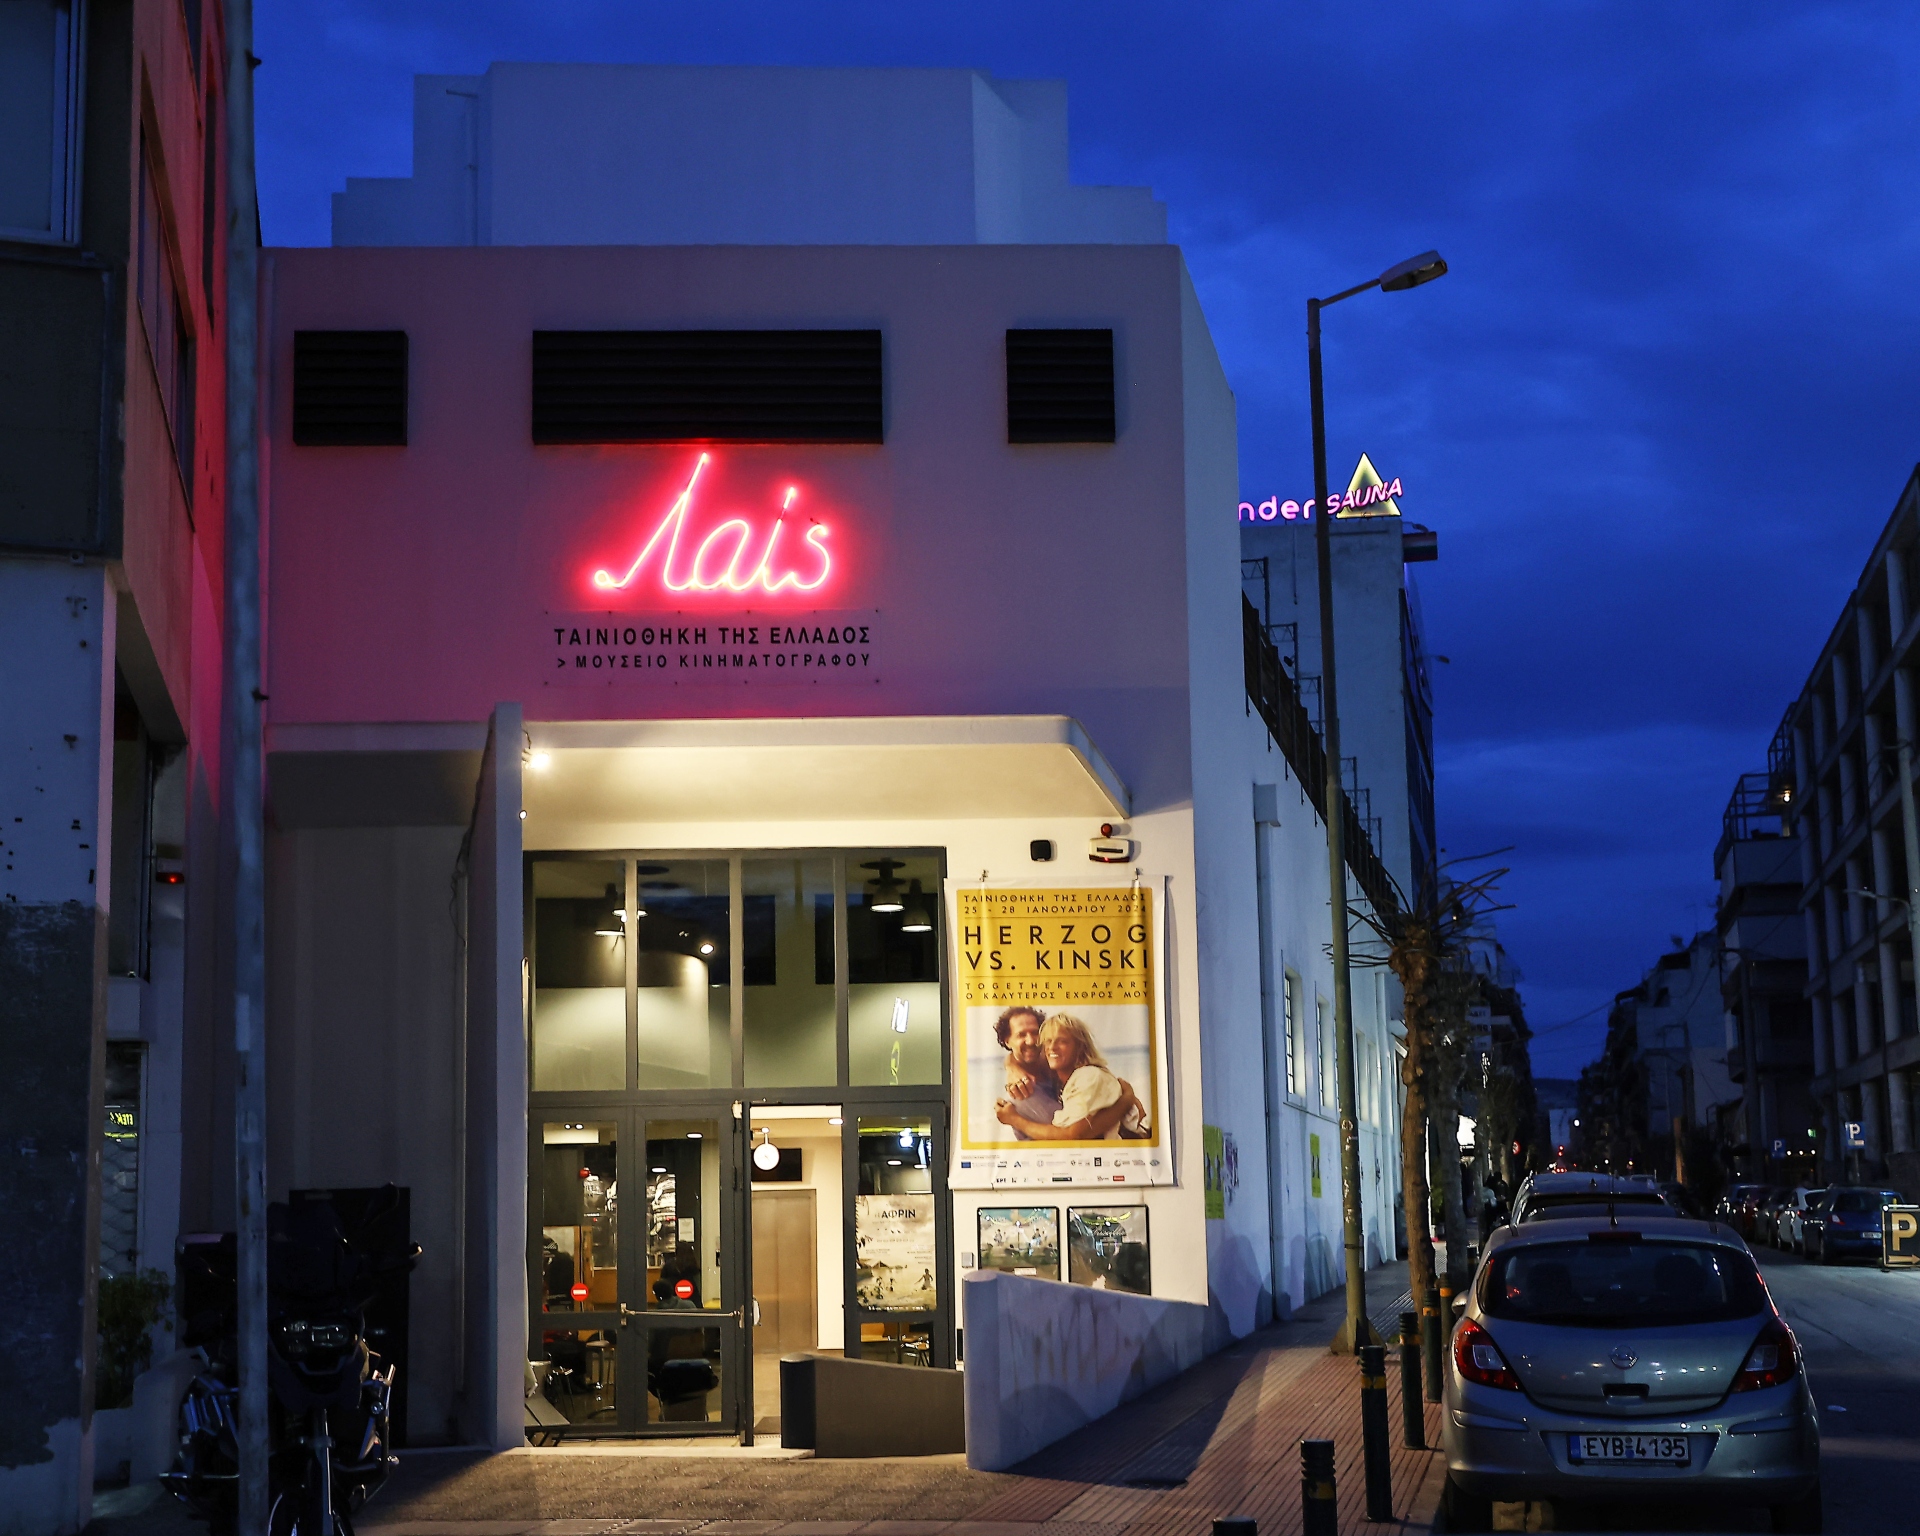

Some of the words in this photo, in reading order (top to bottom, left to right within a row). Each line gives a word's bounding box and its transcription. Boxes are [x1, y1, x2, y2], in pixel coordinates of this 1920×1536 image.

[1327, 477, 1403, 515] SAUNA
[554, 627, 707, 645] ΤΑΙΝΙΟΘΗΚΗ
[718, 627, 759, 645] ΤΗΣ
[770, 626, 870, 644] ΕΛΛΑΔΟΣ
[576, 655, 667, 668] ΜΟΥΣΕΙΟ
[679, 653, 870, 668] ΚΙΝΗΜΑΤΟΓΡΑΦΟΥ
[964, 894, 1044, 903] ΤΑΙΝΙΟΘΗΚΗ
[1054, 894, 1076, 902] ΤΗΣ
[1087, 893, 1146, 901] ΕΛΛΑΔΟΣ
[964, 906, 977, 914] 25
[1002, 906, 1015, 914] 28
[1027, 905, 1106, 914] ΙΑΝΟΥΑΡΙΟΥ
[964, 924, 1147, 945] HERZOG
[965, 950, 1016, 971] VS.
[1036, 949, 1148, 970] KINSKI
[965, 981, 1063, 990] TOGETHER
[1092, 981, 1148, 989] APART
[983, 991, 1055, 1000] ΚΑΛΥΤΕΡΟΣ
[1065, 991, 1113, 999] ΕΧΘΡΟΣ
[1124, 991, 1148, 999] ΜΟΥ
[1850, 1123, 1860, 1139] P
[1774, 1140, 1782, 1151] P
[1891, 1213, 1917, 1251] P
